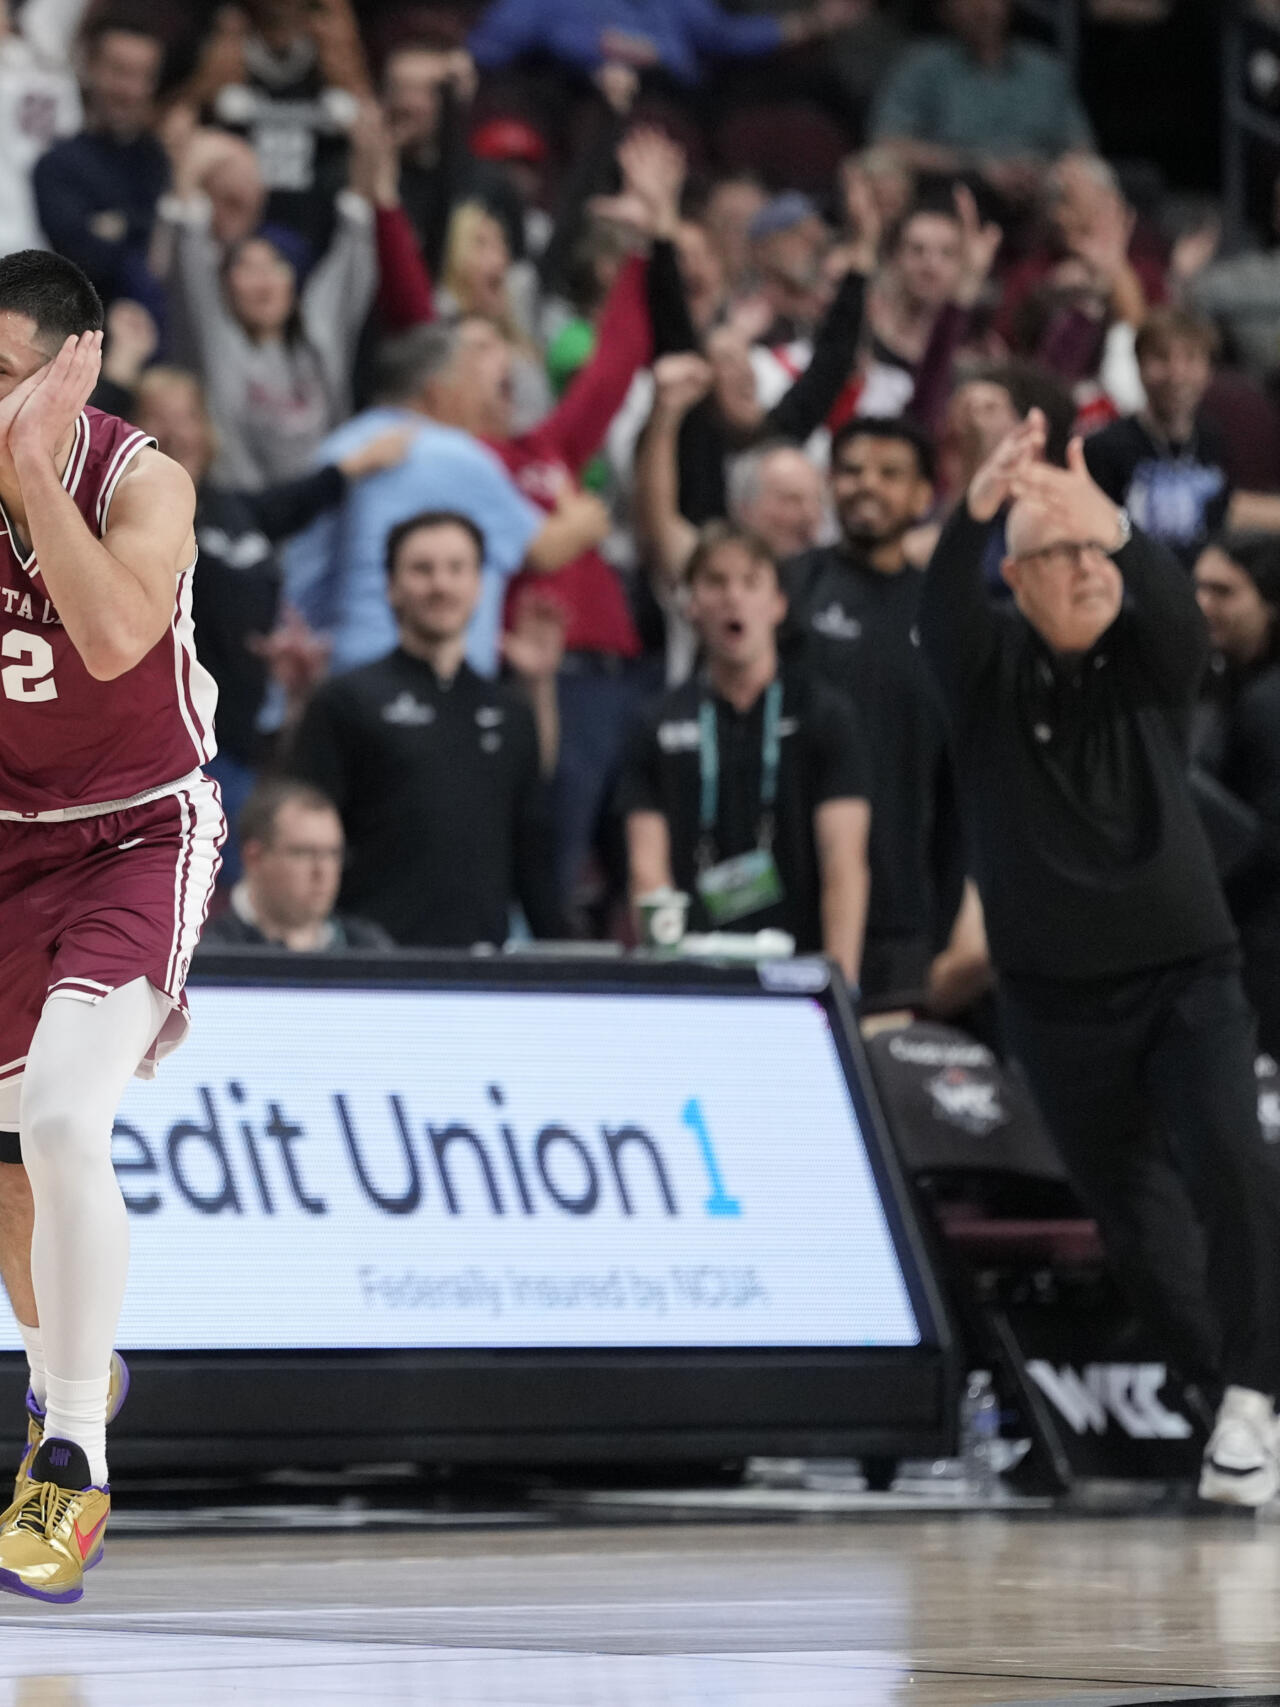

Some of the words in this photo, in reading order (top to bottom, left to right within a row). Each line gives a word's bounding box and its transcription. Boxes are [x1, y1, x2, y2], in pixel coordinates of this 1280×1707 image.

[1, 629, 58, 702] 2
[332, 1084, 681, 1217] Union
[1024, 1359, 1193, 1439] WCC
